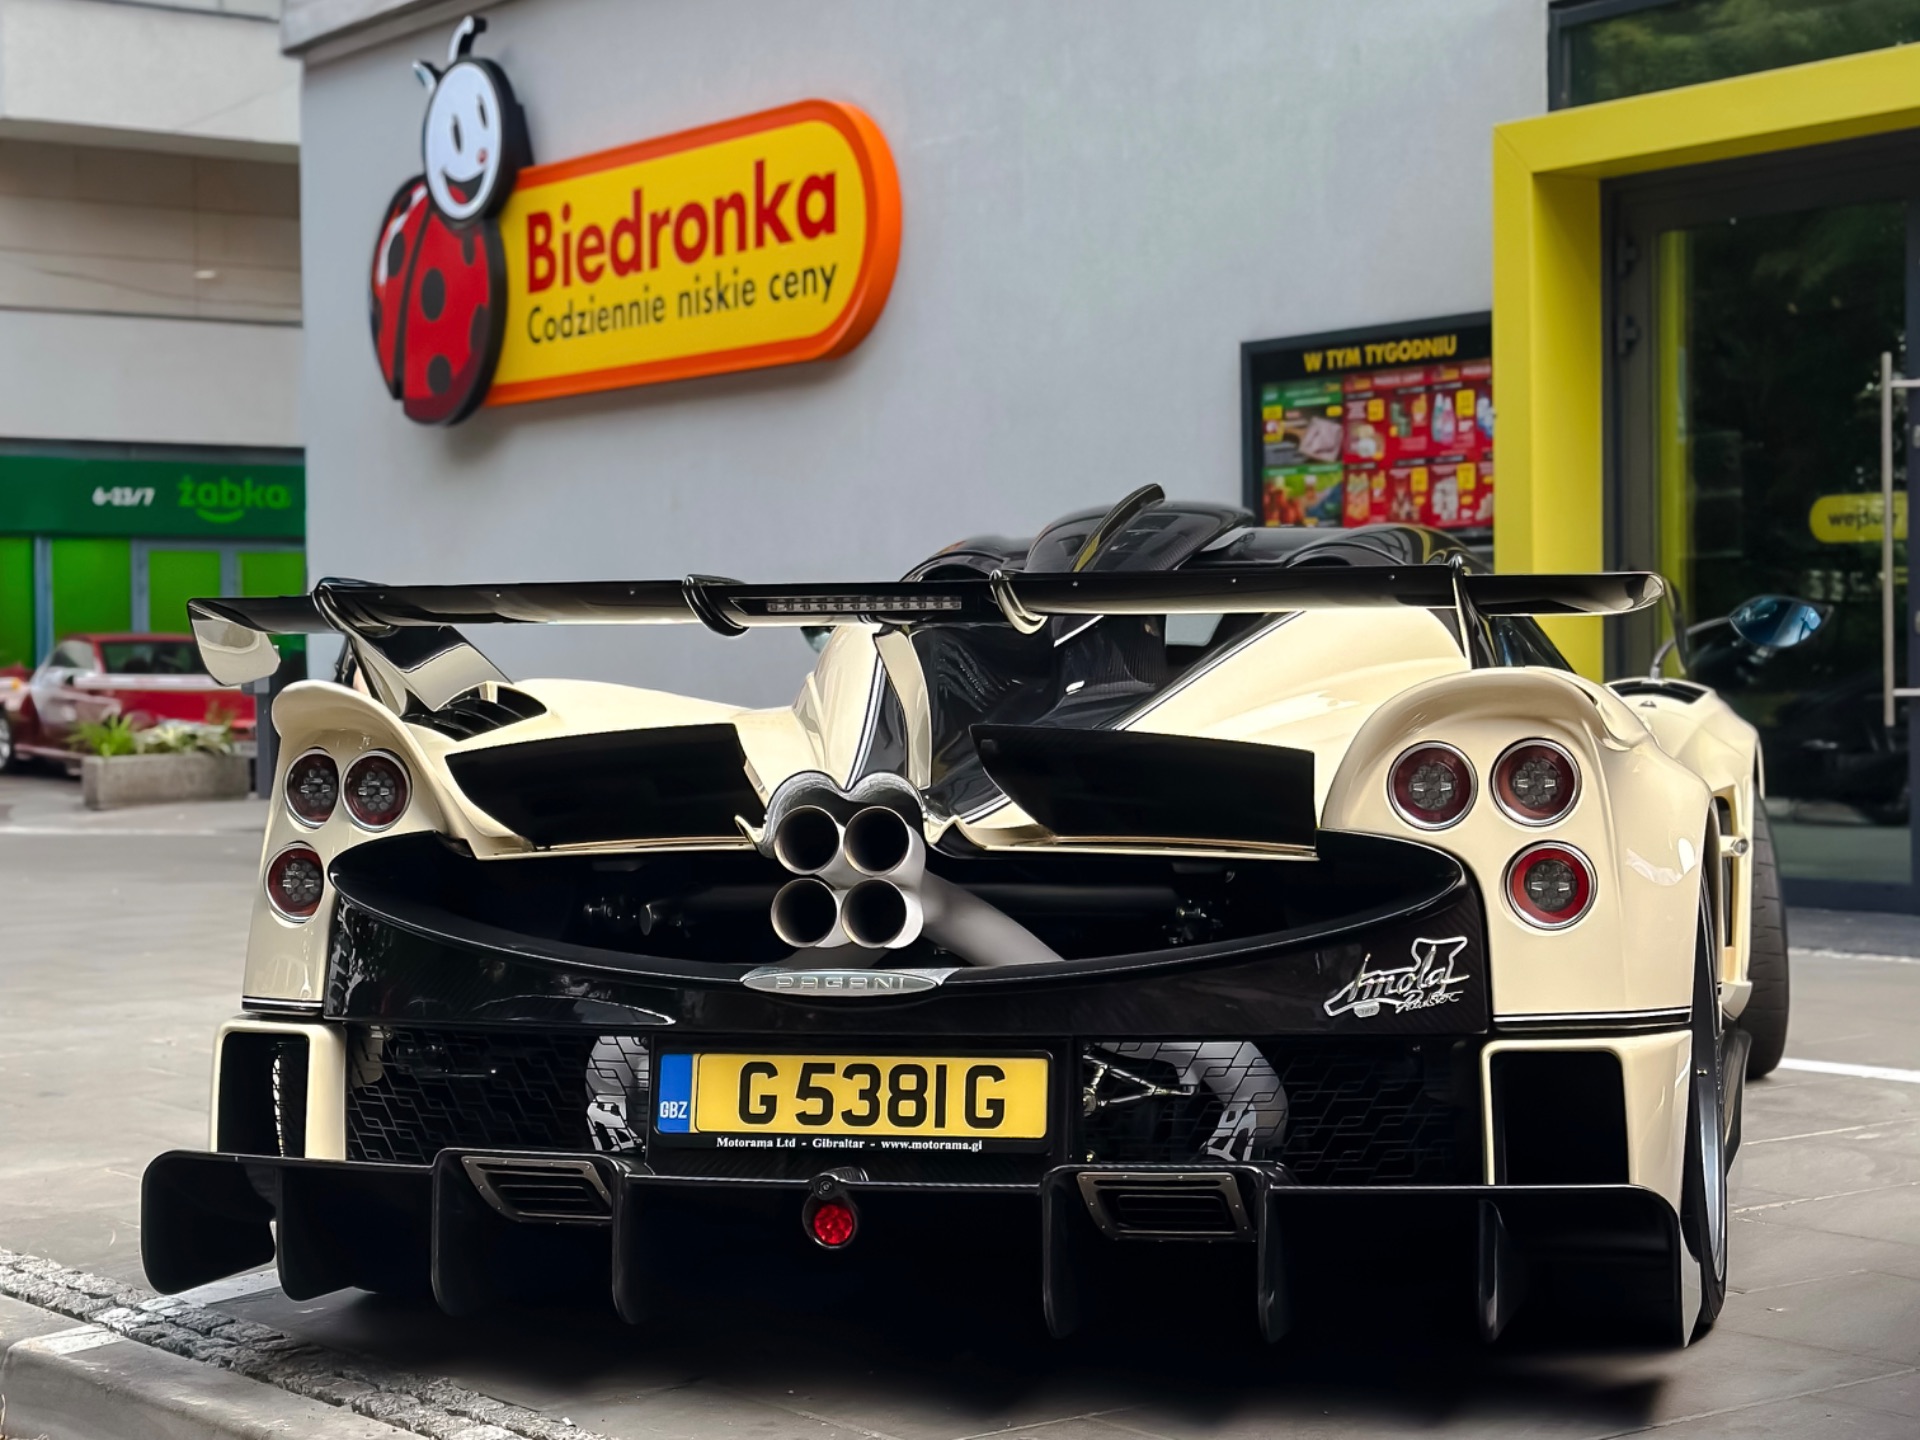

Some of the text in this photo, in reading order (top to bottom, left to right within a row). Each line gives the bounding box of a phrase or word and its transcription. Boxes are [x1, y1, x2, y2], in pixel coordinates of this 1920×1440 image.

[526, 158, 837, 295] Biedronka
[527, 263, 838, 345] Codziennie niskie ceny
[1303, 334, 1457, 373] W TYM TYGODNIU
[178, 475, 292, 509] żabka
[775, 976, 905, 990] PAGANI
[659, 1100, 688, 1120] GBZ
[738, 1061, 1006, 1130] G 5381 G
[716, 1136, 773, 1151] Motorama
[775, 1137, 796, 1149] Ltd
[812, 1137, 866, 1150] Gibraltar
[881, 1139, 983, 1153] www.motorama.gi
